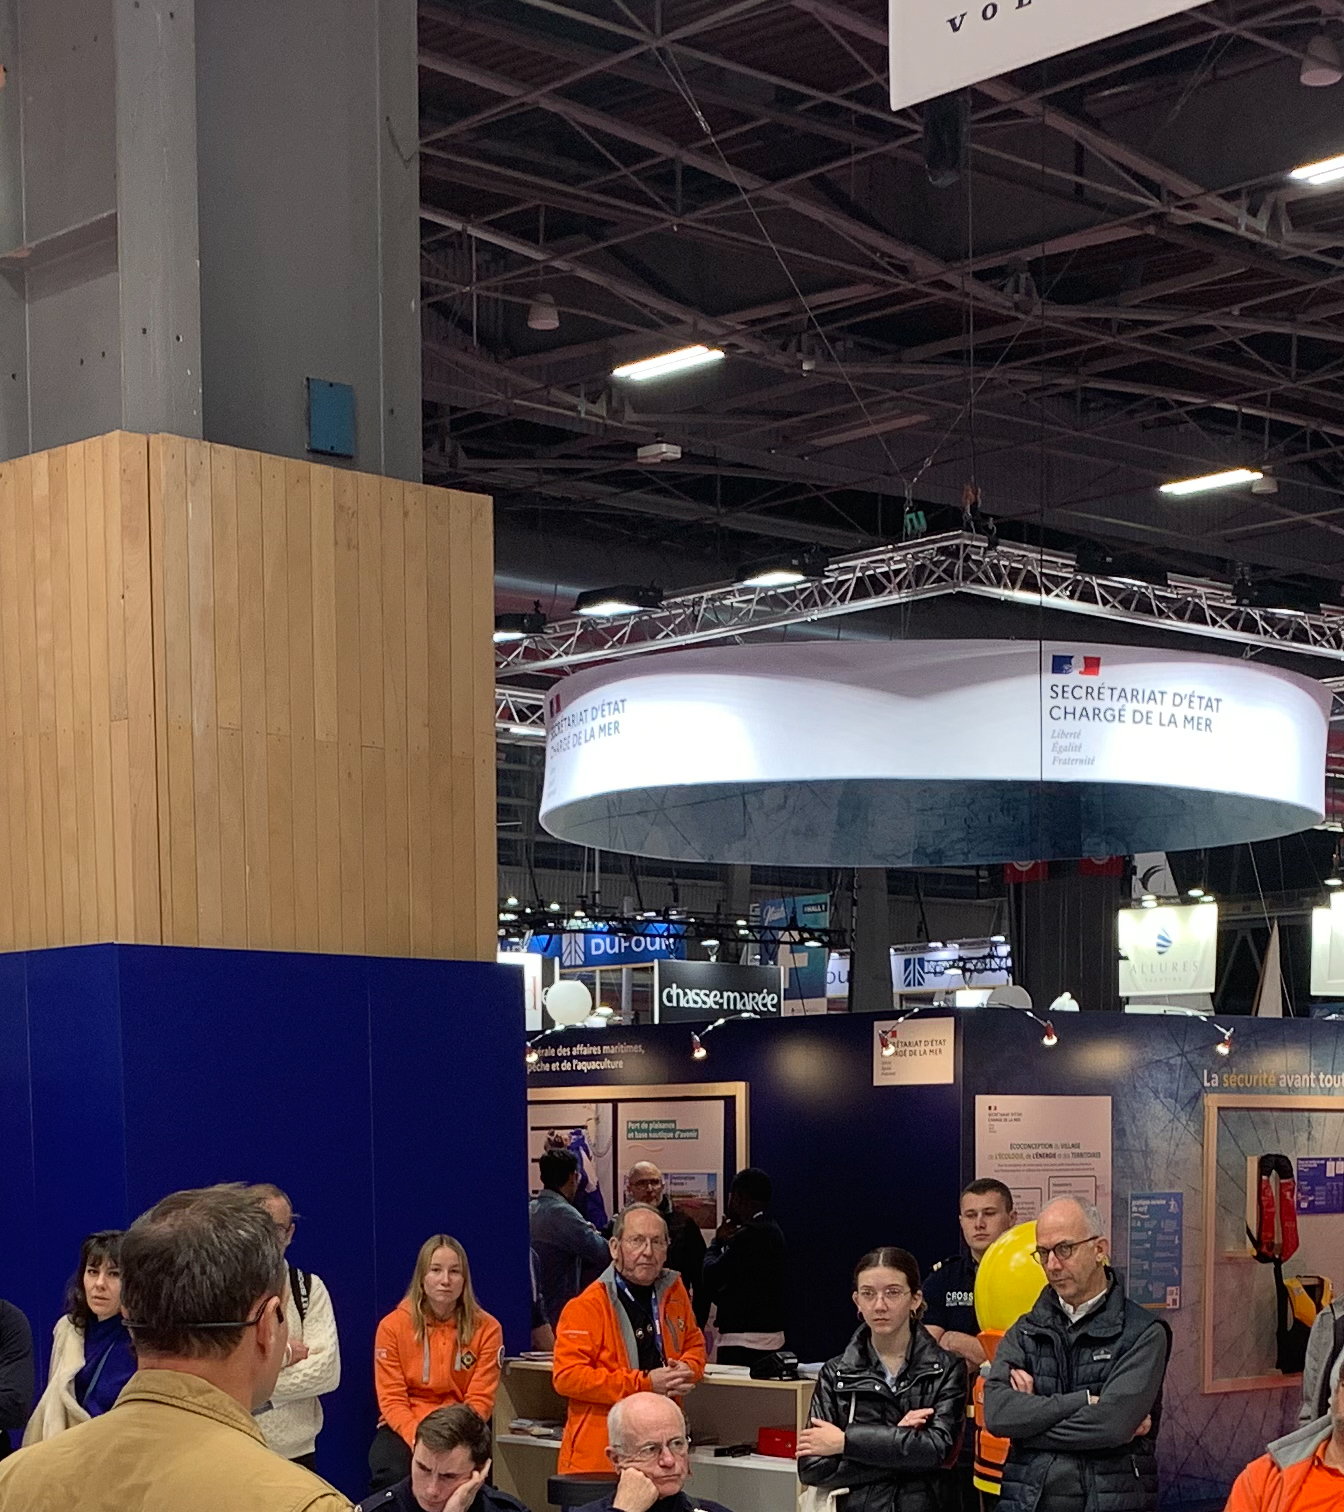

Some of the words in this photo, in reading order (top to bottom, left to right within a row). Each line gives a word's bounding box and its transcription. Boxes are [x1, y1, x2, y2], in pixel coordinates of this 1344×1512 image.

[1050, 683, 1168, 706] SECRÉTARIAT
[1172, 690, 1223, 714] D'ÉTAT
[591, 698, 627, 722] D'ÉTAT
[1049, 705, 1127, 724] CHARGÉ
[1132, 709, 1153, 726] DE
[1159, 712, 1178, 728] LA
[1183, 715, 1213, 733] MER
[572, 732, 582, 748] DE
[584, 727, 596, 743] LA
[598, 720, 621, 739] MER
[1051, 729, 1082, 740] Liberté
[1051, 742, 1083, 755] Égalité
[1052, 755, 1096, 766] Fraternité
[1129, 960, 1199, 975] ALLURES
[557, 1045, 570, 1057] des
[572, 1043, 601, 1055] affaires
[603, 1042, 645, 1054] maritimes,
[908, 1049, 918, 1057] DE
[918, 1049, 927, 1057] LA
[929, 1047, 943, 1056] MER
[551, 1061, 560, 1071] et
[561, 1060, 572, 1071] de
[573, 1058, 624, 1073] l'aquaculture
[1203, 1069, 1219, 1087] La
[1222, 1067, 1277, 1087] sécurité
[1279, 1071, 1316, 1087] avant
[945, 1291, 974, 1301] CROSS
